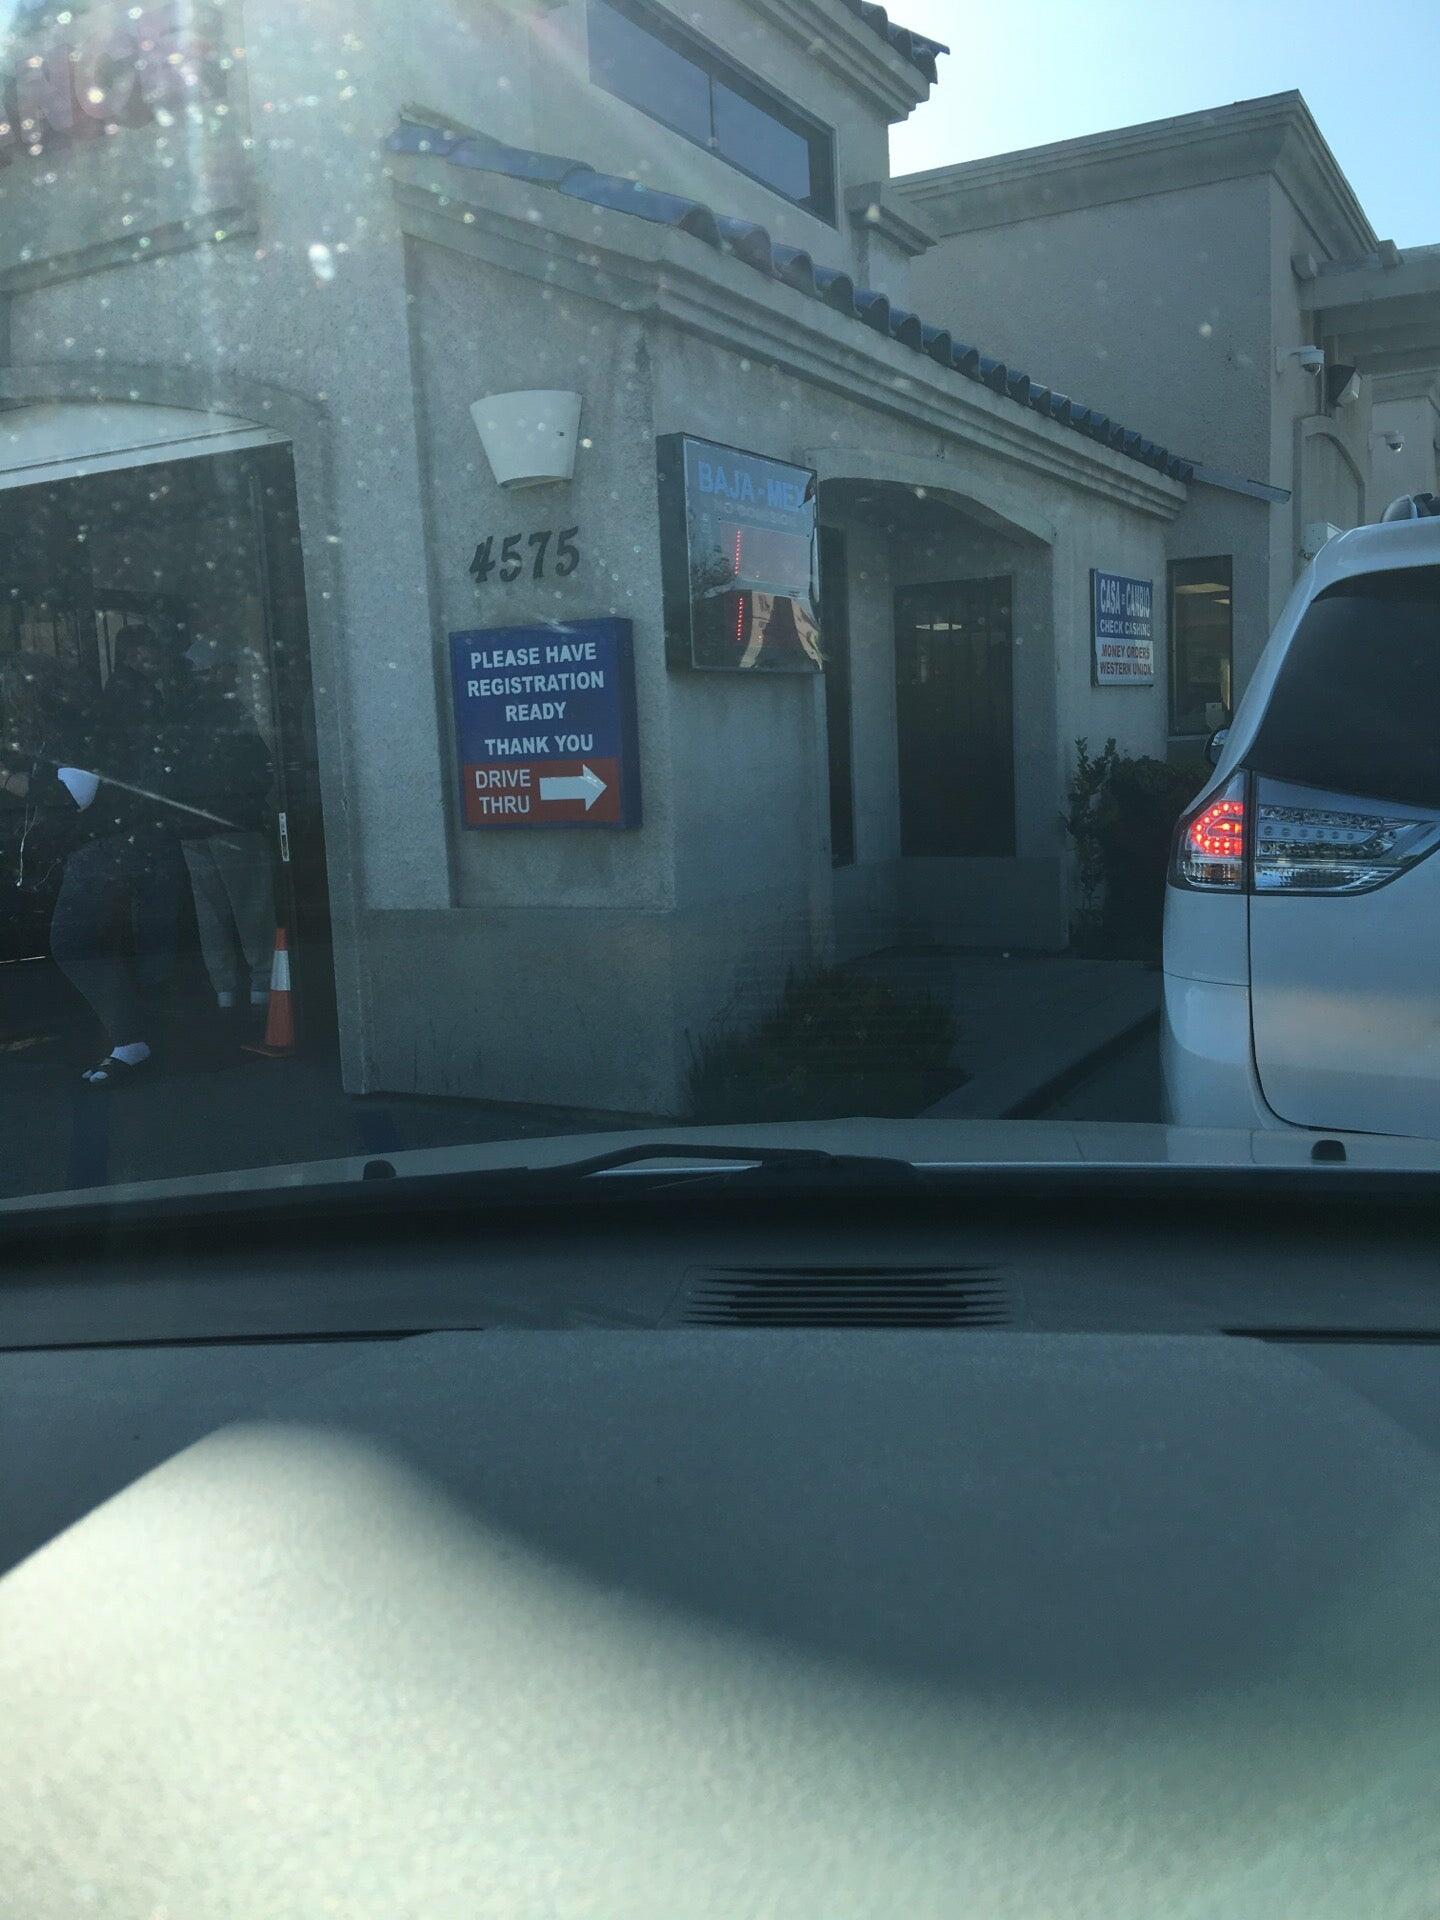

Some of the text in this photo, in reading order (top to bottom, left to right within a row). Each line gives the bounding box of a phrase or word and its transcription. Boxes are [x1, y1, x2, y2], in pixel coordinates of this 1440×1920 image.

[469, 525, 580, 583] 4575
[1100, 579, 1120, 615] CASA
[1100, 619, 1151, 637] CHECK CASHING
[470, 643, 597, 669] PLEASE HAVE
[1101, 643, 1150, 660] MONEY ORDERS
[1100, 661, 1152, 676] WESTERN UNION
[467, 670, 604, 697] REGISTRATION
[505, 701, 566, 722] READY
[484, 733, 594, 756] THANK YOU
[475, 769, 531, 789] DRIVE
[479, 795, 530, 815] THRU
